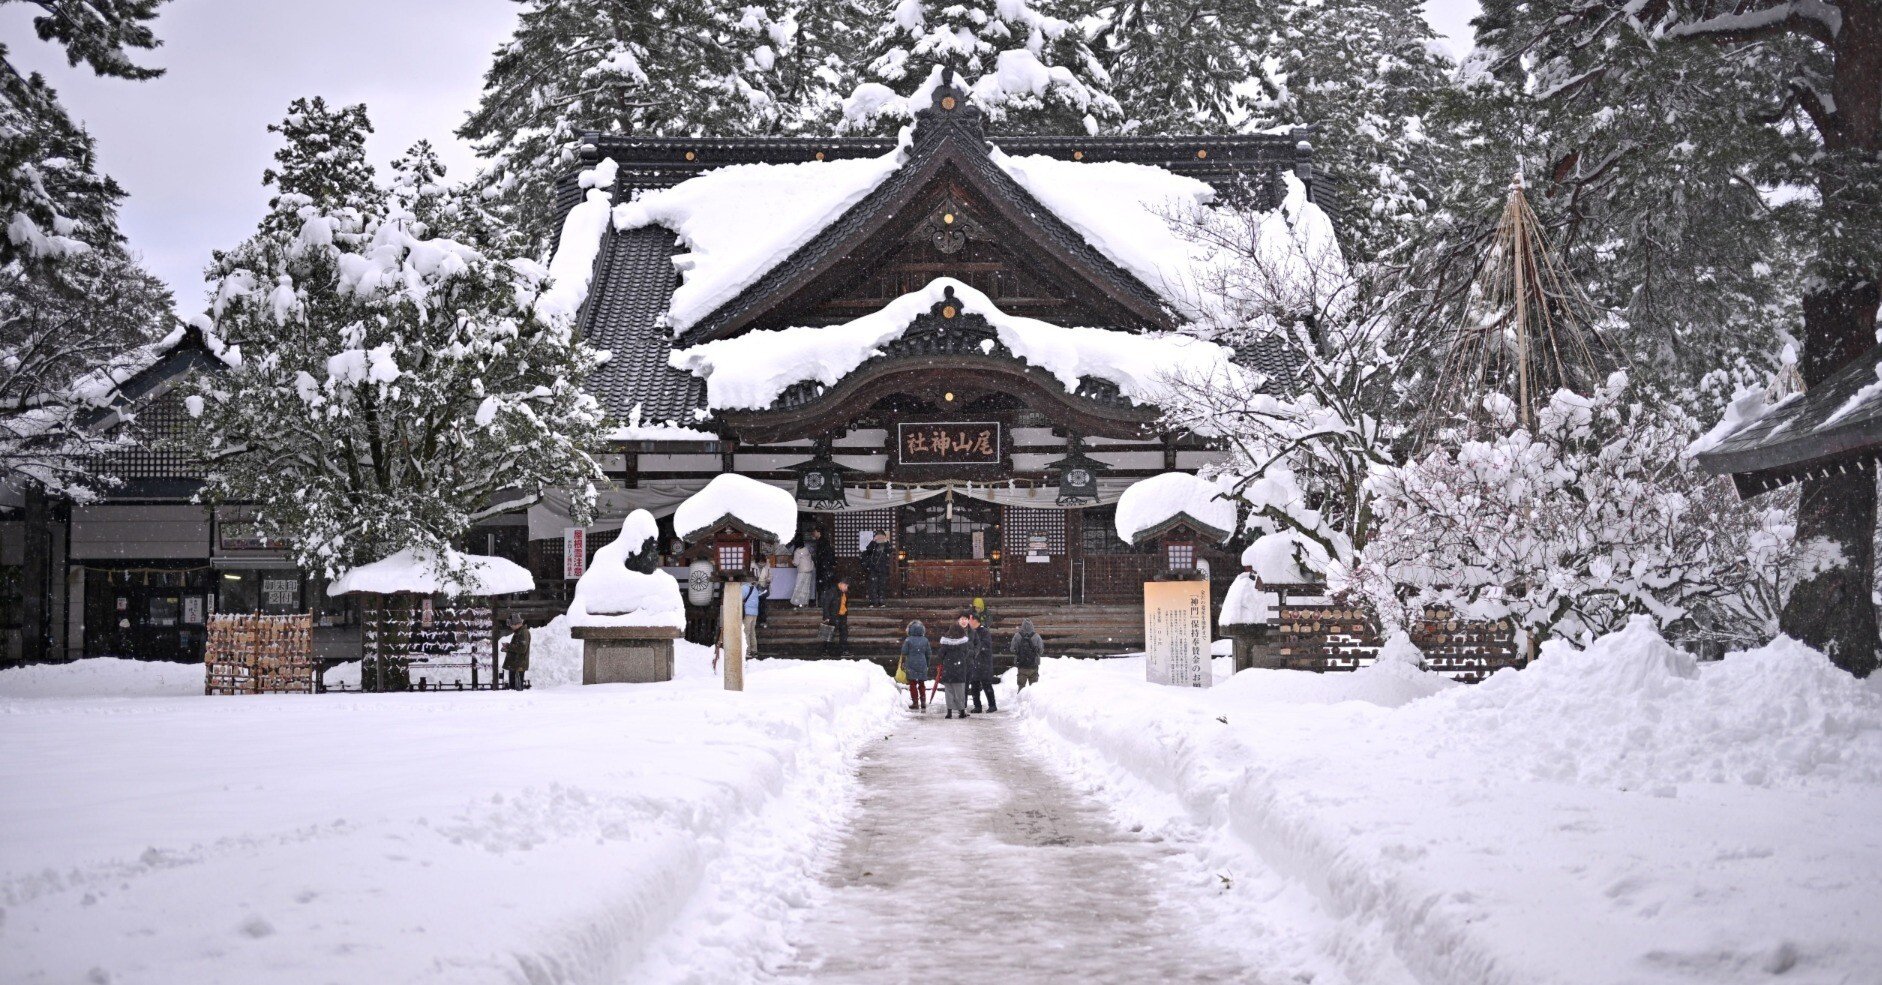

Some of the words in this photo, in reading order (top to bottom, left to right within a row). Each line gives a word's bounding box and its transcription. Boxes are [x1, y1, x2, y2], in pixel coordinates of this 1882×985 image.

[907, 430, 994, 456] 尾山神社
[574, 530, 582, 576] 屋根雪注意
[264, 580, 297, 590] 御朱印
[270, 592, 290, 604] 受付
